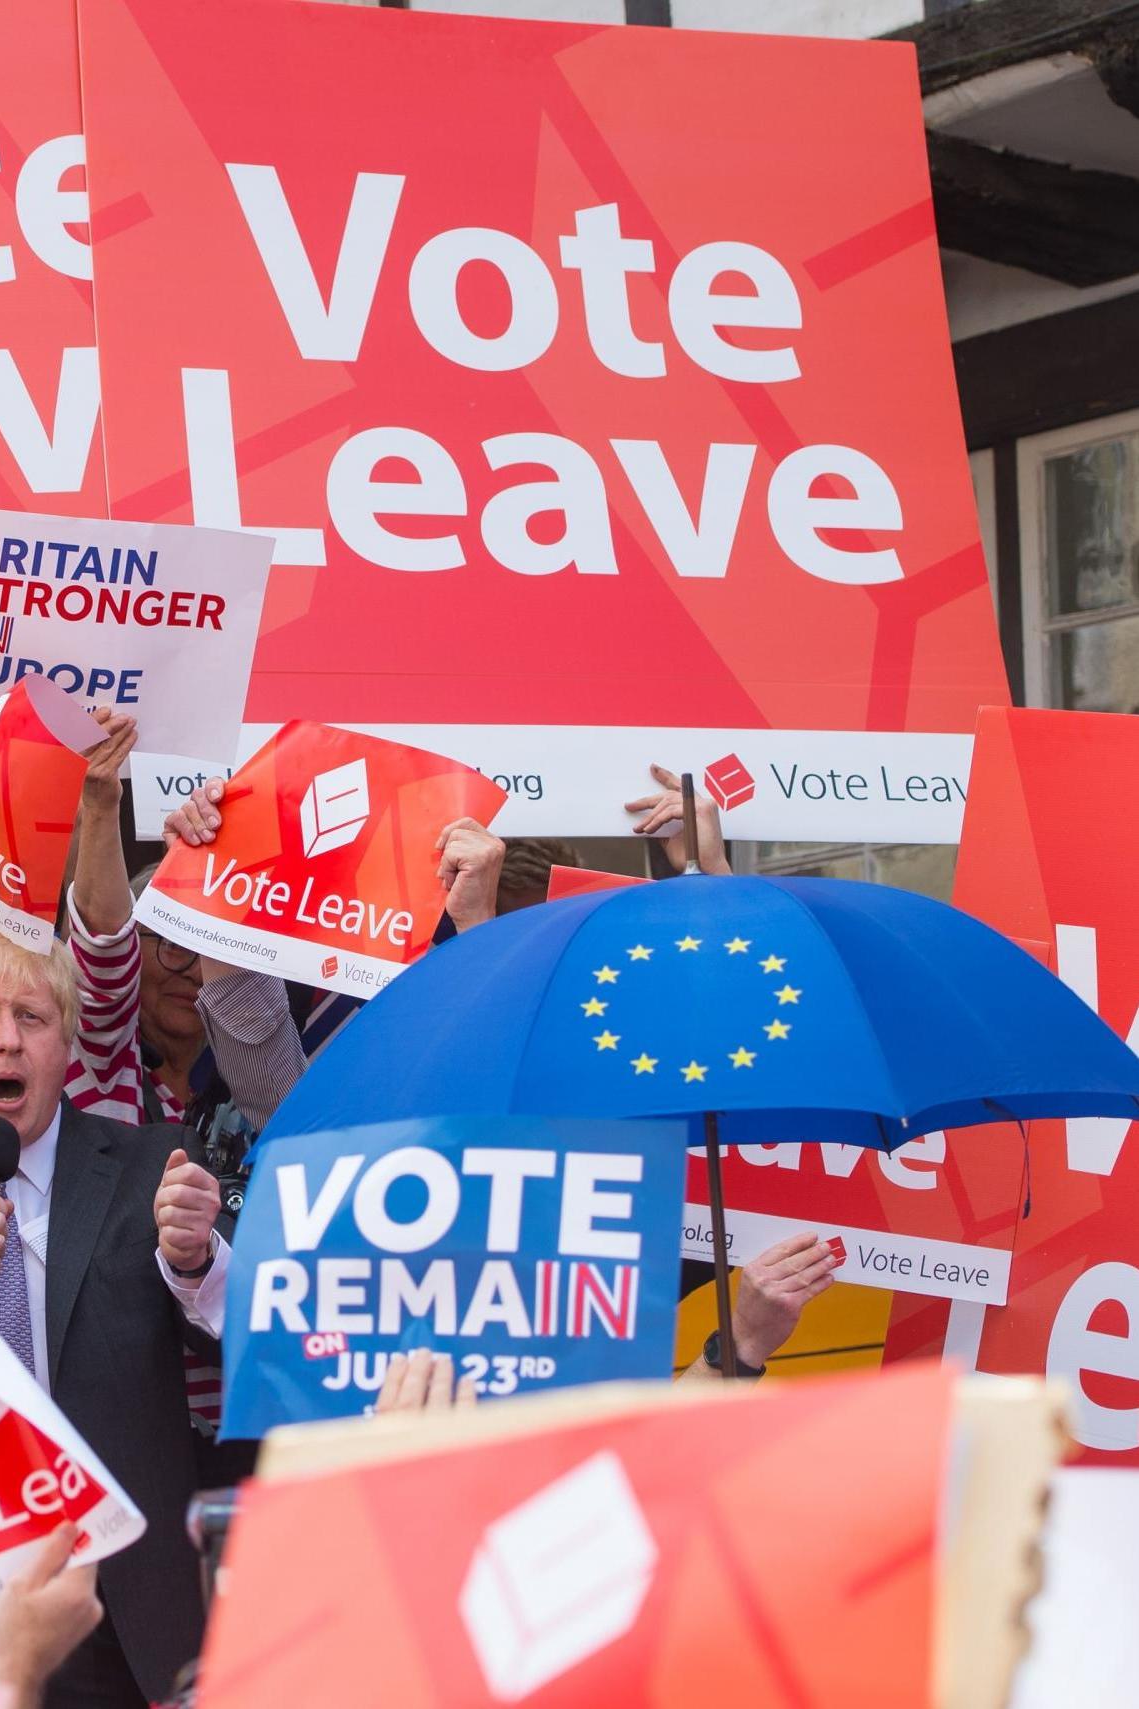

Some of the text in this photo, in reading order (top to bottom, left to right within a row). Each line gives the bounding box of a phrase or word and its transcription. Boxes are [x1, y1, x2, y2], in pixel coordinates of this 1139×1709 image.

[224, 162, 803, 384] Vote
[180, 366, 906, 587] Leave
[769, 763, 869, 801] Vote
[151, 905, 279, 961] voteleavetakecontrol.org
[202, 853, 414, 946] Vote Leave
[344, 962, 374, 985] Vote
[276, 1145, 644, 1260] VOTE
[249, 1258, 640, 1341] REMAIN
[858, 1245, 991, 1287] Vote Leave
[305, 1334, 345, 1356] ON
